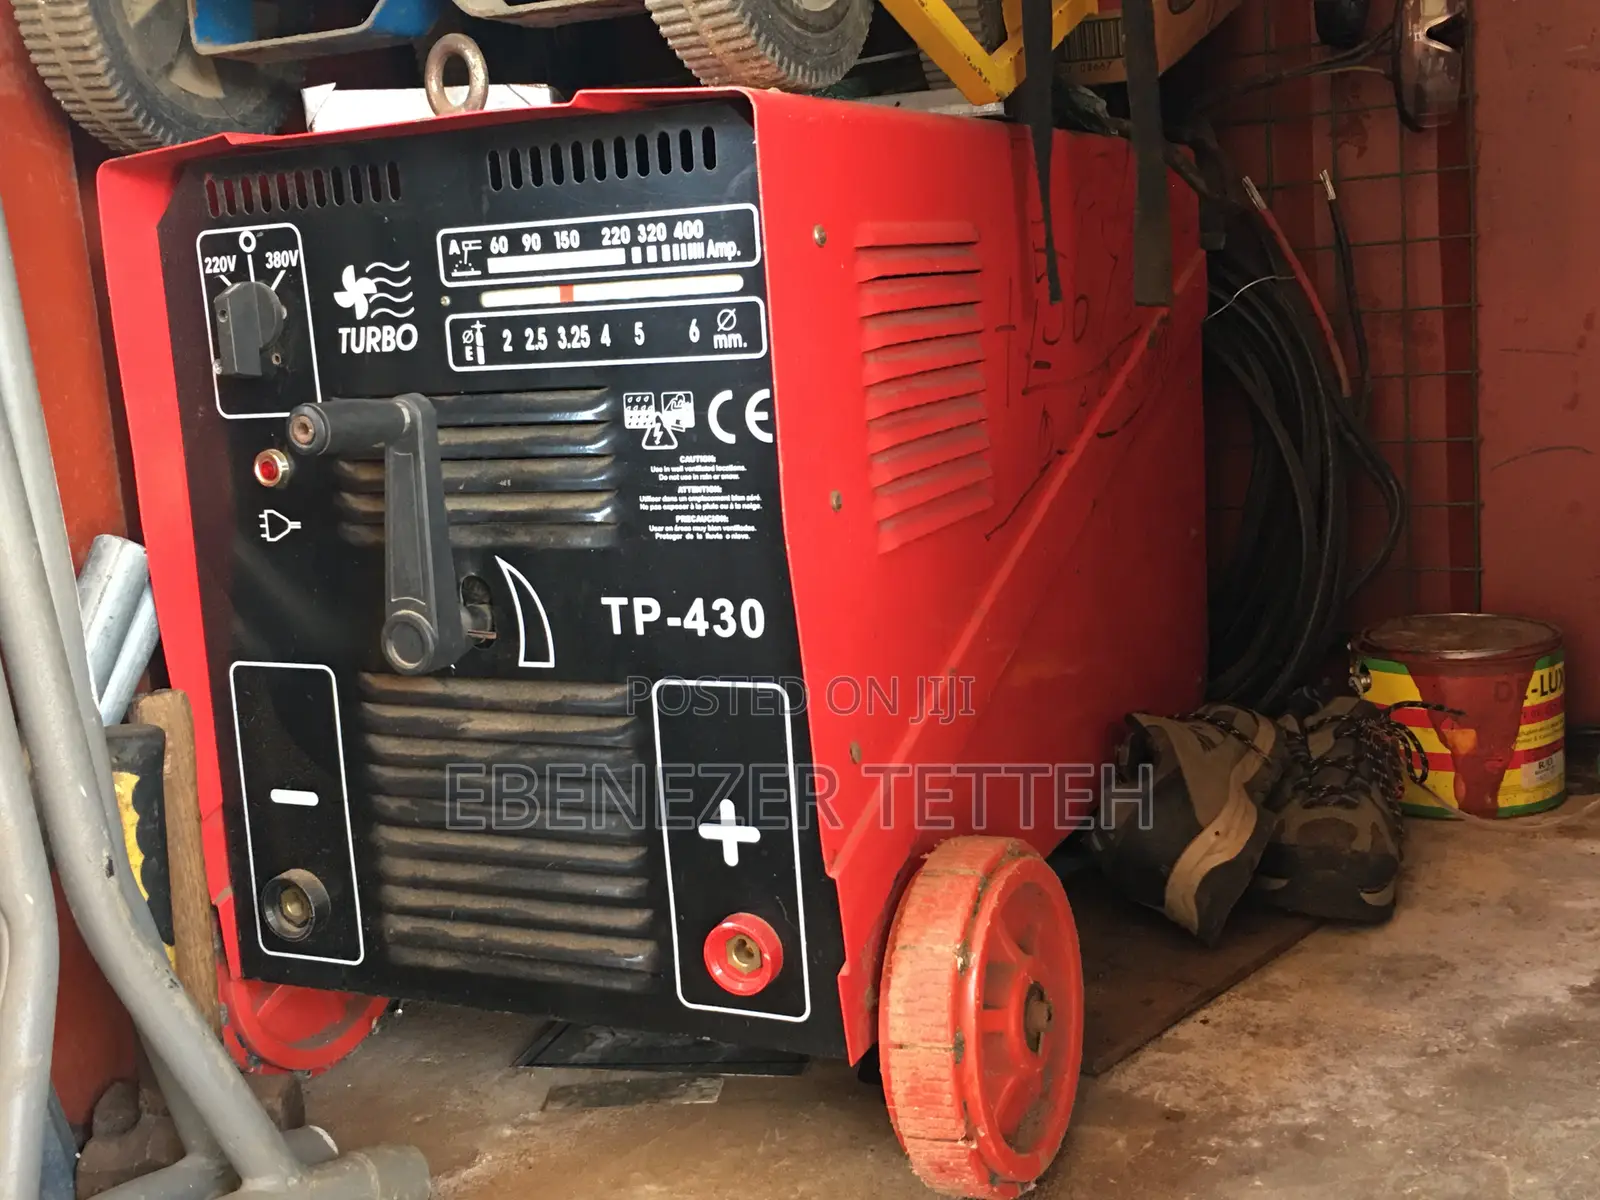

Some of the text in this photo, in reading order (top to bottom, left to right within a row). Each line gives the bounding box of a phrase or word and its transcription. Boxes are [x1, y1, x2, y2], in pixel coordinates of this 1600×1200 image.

[490, 219, 703, 254] 60 90 150 220 320 400
[449, 240, 460, 255] A
[706, 238, 741, 260] Amp.
[204, 255, 237, 274] 220V
[265, 250, 299, 270] 380V
[338, 323, 418, 354] TURBO
[502, 319, 748, 352] 2 2.5 3.25 4 5 6 mm.
[679, 455, 716, 463] CAUTION:
[678, 485, 722, 493] ATTENTION:
[601, 597, 765, 639] TP-430
